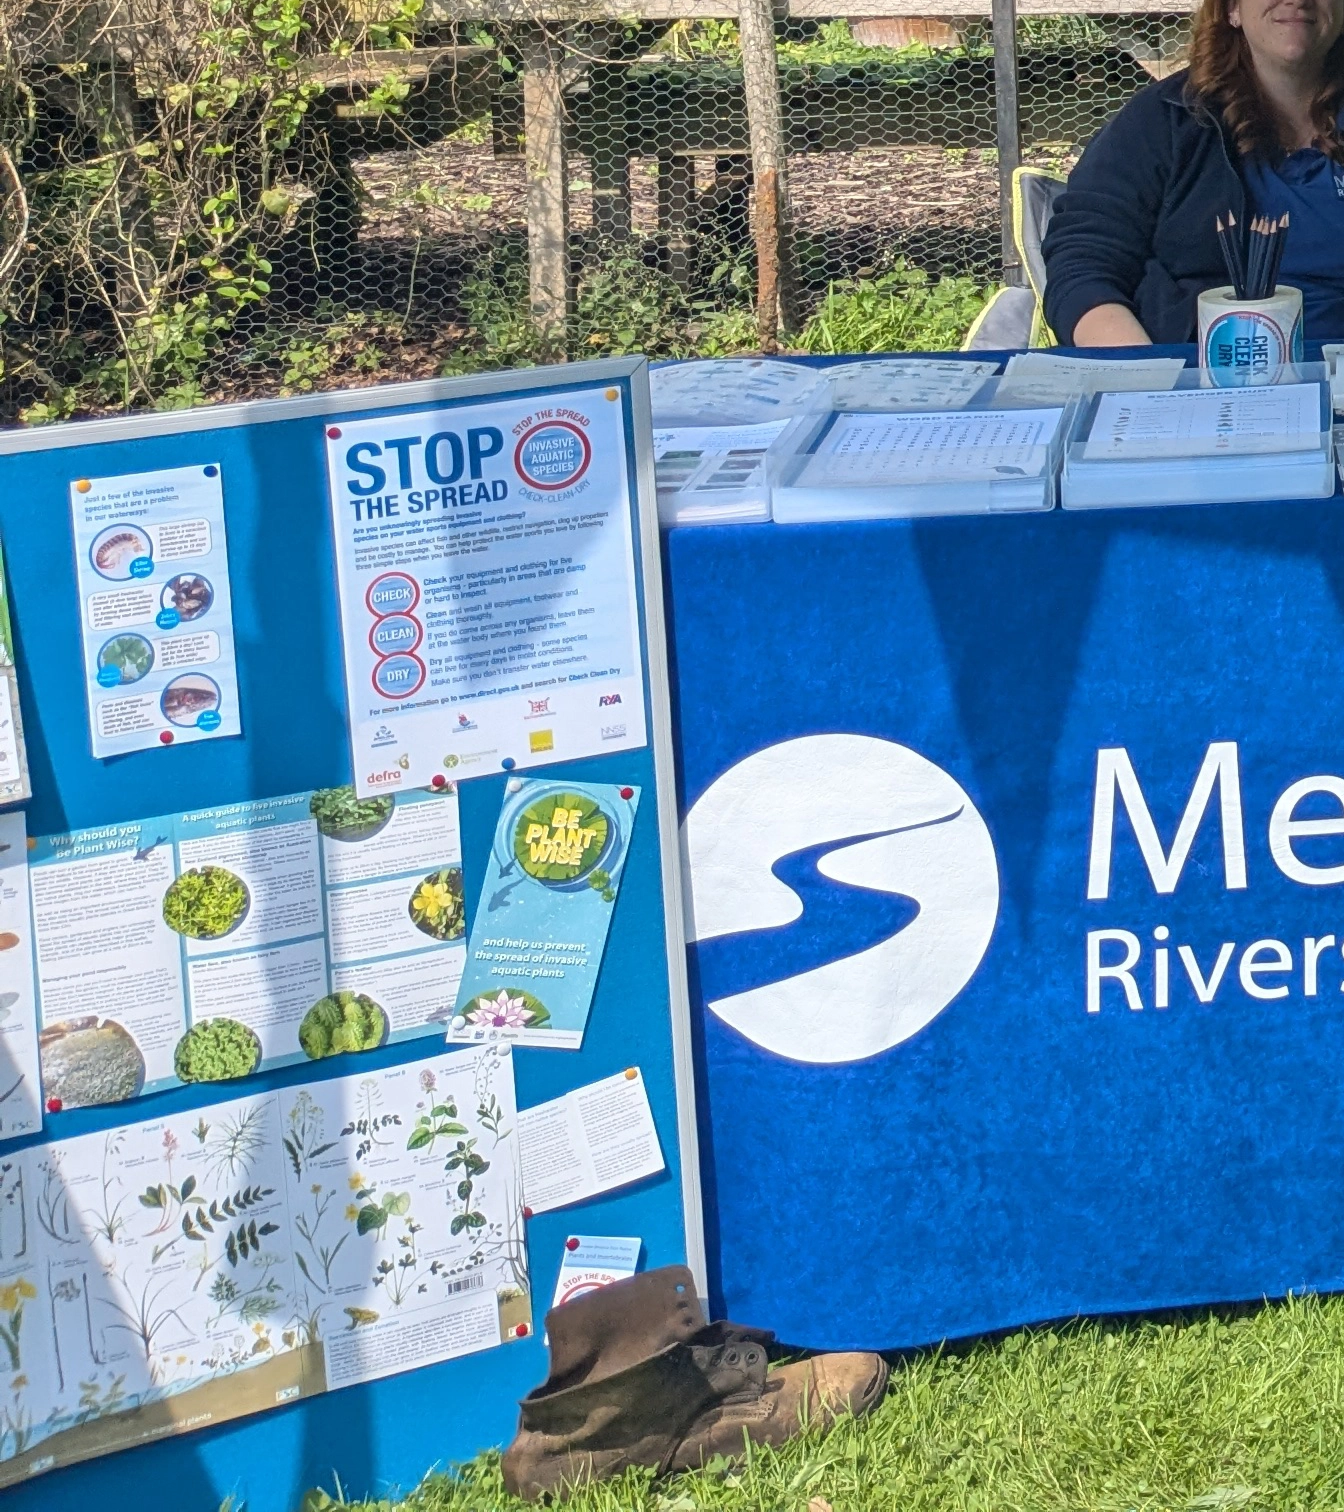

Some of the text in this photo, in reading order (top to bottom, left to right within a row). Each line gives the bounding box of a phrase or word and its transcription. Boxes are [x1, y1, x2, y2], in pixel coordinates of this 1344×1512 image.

[1218, 344, 1232, 367] DRY
[1235, 337, 1251, 376] CLEAN
[1252, 335, 1268, 376] CHECK
[512, 408, 590, 437] STOP THE SPREAD
[528, 438, 575, 453] INVASIVE
[345, 425, 504, 497] STOP
[531, 449, 575, 465] AQUATIC
[533, 461, 575, 477] SPECIES
[84, 494, 100, 504] Just
[108, 493, 122, 502] few
[123, 491, 131, 499] of
[132, 489, 145, 498] the
[146, 486, 175, 496] invasive
[84, 503, 112, 514] species
[113, 500, 129, 510] that
[130, 499, 143, 507] are
[150, 494, 180, 505] problem
[350, 479, 508, 520] THE SPREAD
[94, 513, 107, 521] our
[373, 586, 411, 605] CHECK
[376, 625, 414, 644] CLEAN
[386, 666, 411, 684] DRY
[599, 693, 622, 707] RYA
[367, 770, 401, 785] defra
[182, 795, 304, 823] A quick guide to five invasive
[552, 807, 583, 830] BE
[214, 813, 276, 831] aquatic plants
[49, 825, 142, 849] Why should you
[525, 823, 597, 849] PLANT
[72, 841, 106, 857] Plant
[106, 836, 140, 852] Wise?
[529, 841, 585, 867] WISE
[482, 936, 587, 954] and help us prevent
[474, 949, 588, 967] the spread of invasive
[491, 965, 566, 979] aquatic plants
[562, 1272, 600, 1289] STOP THE
